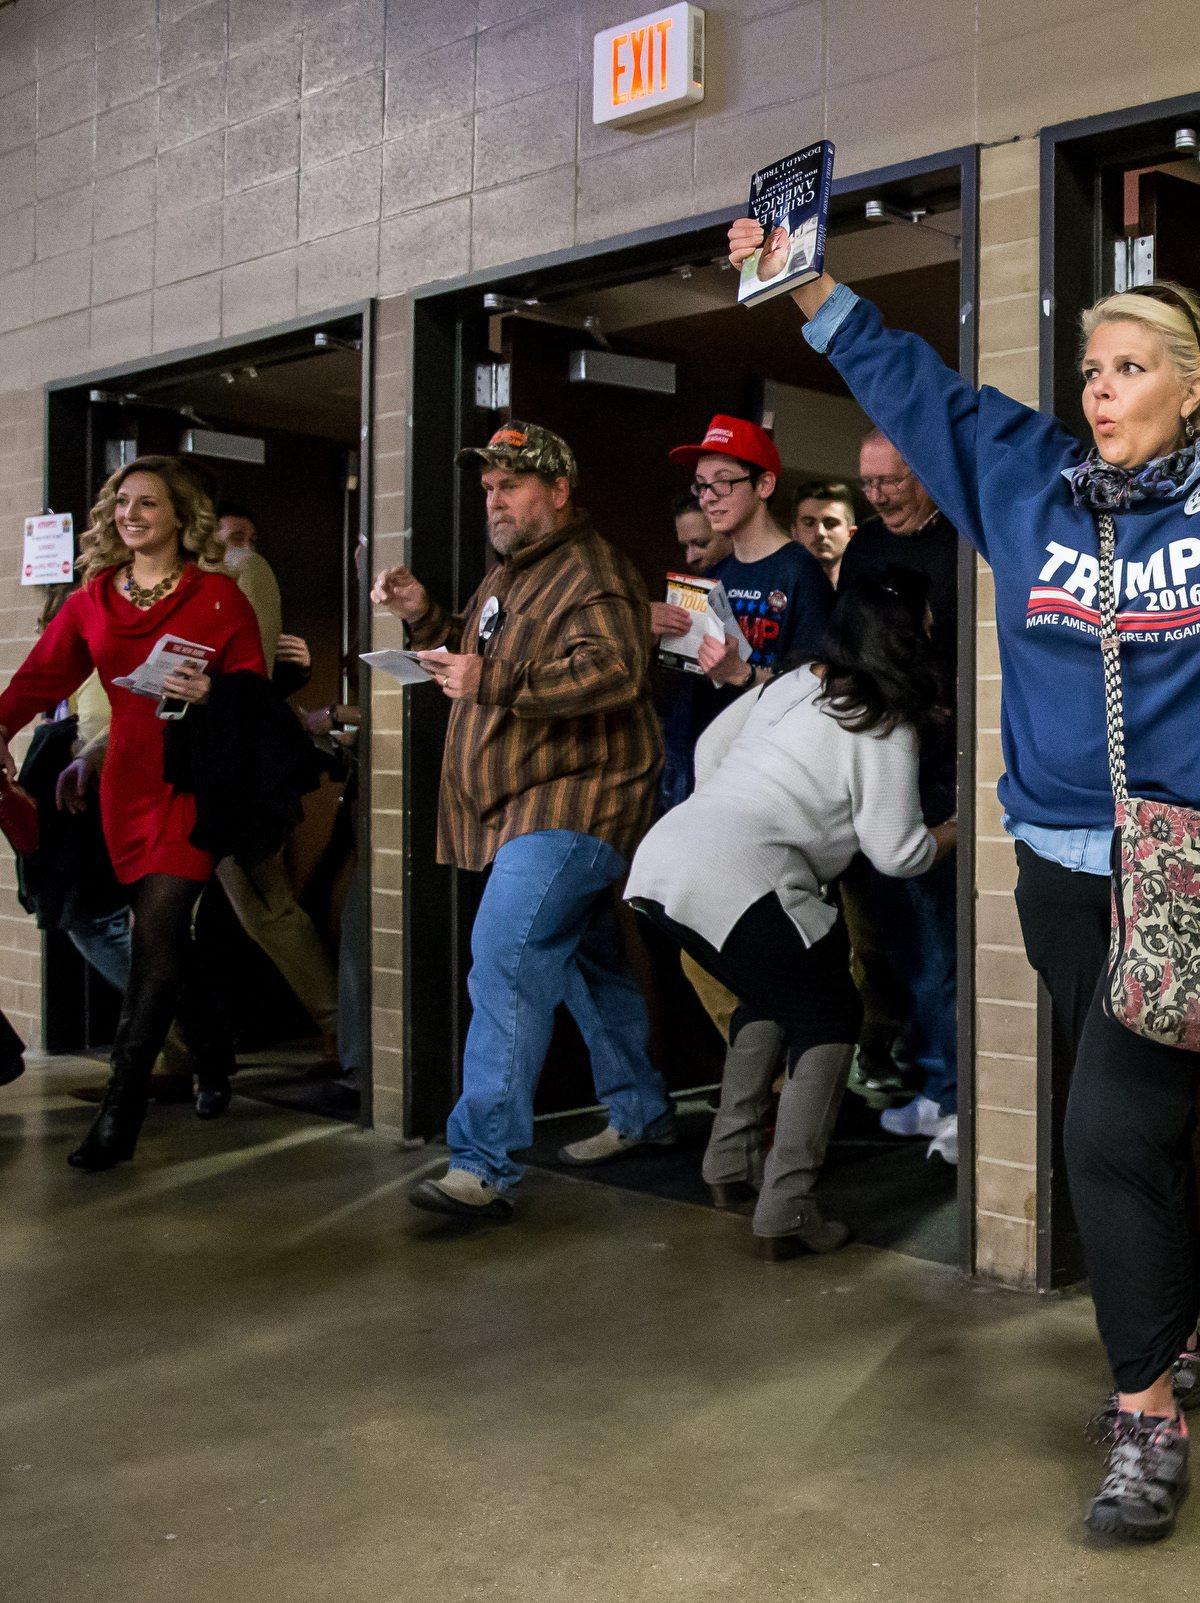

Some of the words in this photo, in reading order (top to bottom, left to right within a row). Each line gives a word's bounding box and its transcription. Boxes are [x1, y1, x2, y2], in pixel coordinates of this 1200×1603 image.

[611, 17, 673, 107] EXIT
[786, 146, 821, 168] DONALD
[753, 167, 779, 186] TRUMP
[804, 168, 818, 178] HOW
[753, 177, 815, 217] AMERICA
[756, 190, 815, 226] CRIPPLE
[680, 592, 708, 613] TOUG
[727, 588, 762, 600] ONALD
[1026, 613, 1060, 629] MAKE
[1061, 615, 1105, 638] AMERI
[1118, 632, 1160, 643] GREAT
